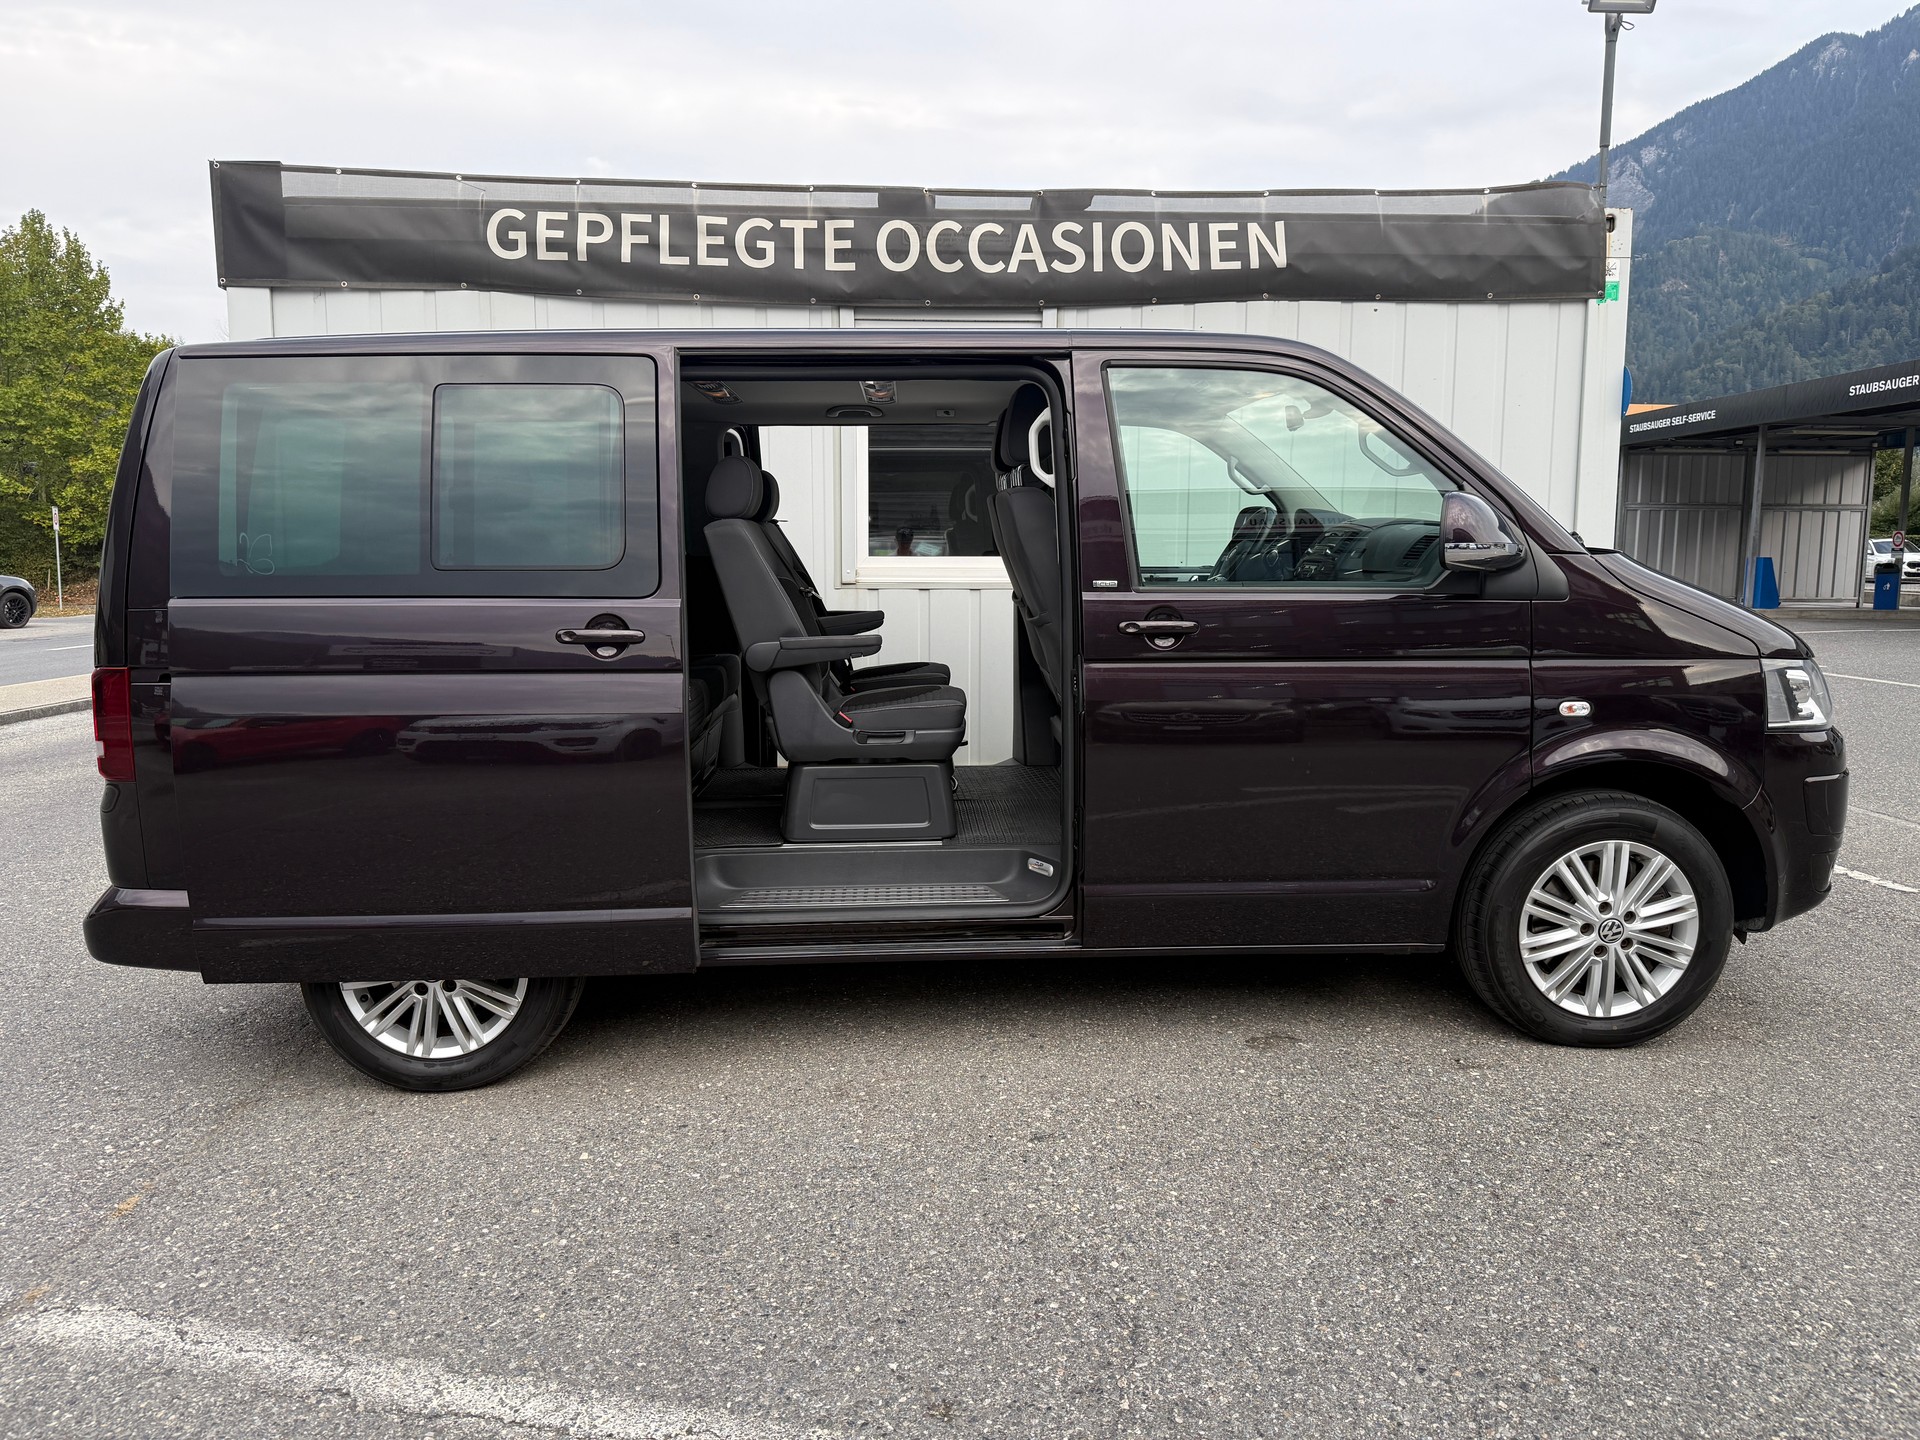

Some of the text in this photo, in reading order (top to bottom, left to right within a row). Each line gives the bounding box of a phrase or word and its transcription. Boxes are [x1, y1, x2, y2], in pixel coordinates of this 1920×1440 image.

[485, 207, 857, 272] GEPFLEGTE
[875, 219, 1288, 274] OCCASIONEN
[1848, 374, 1920, 397] STAUBSAUGER
[1629, 410, 1716, 433] STAUBSAUGER SELF-SERVICE
